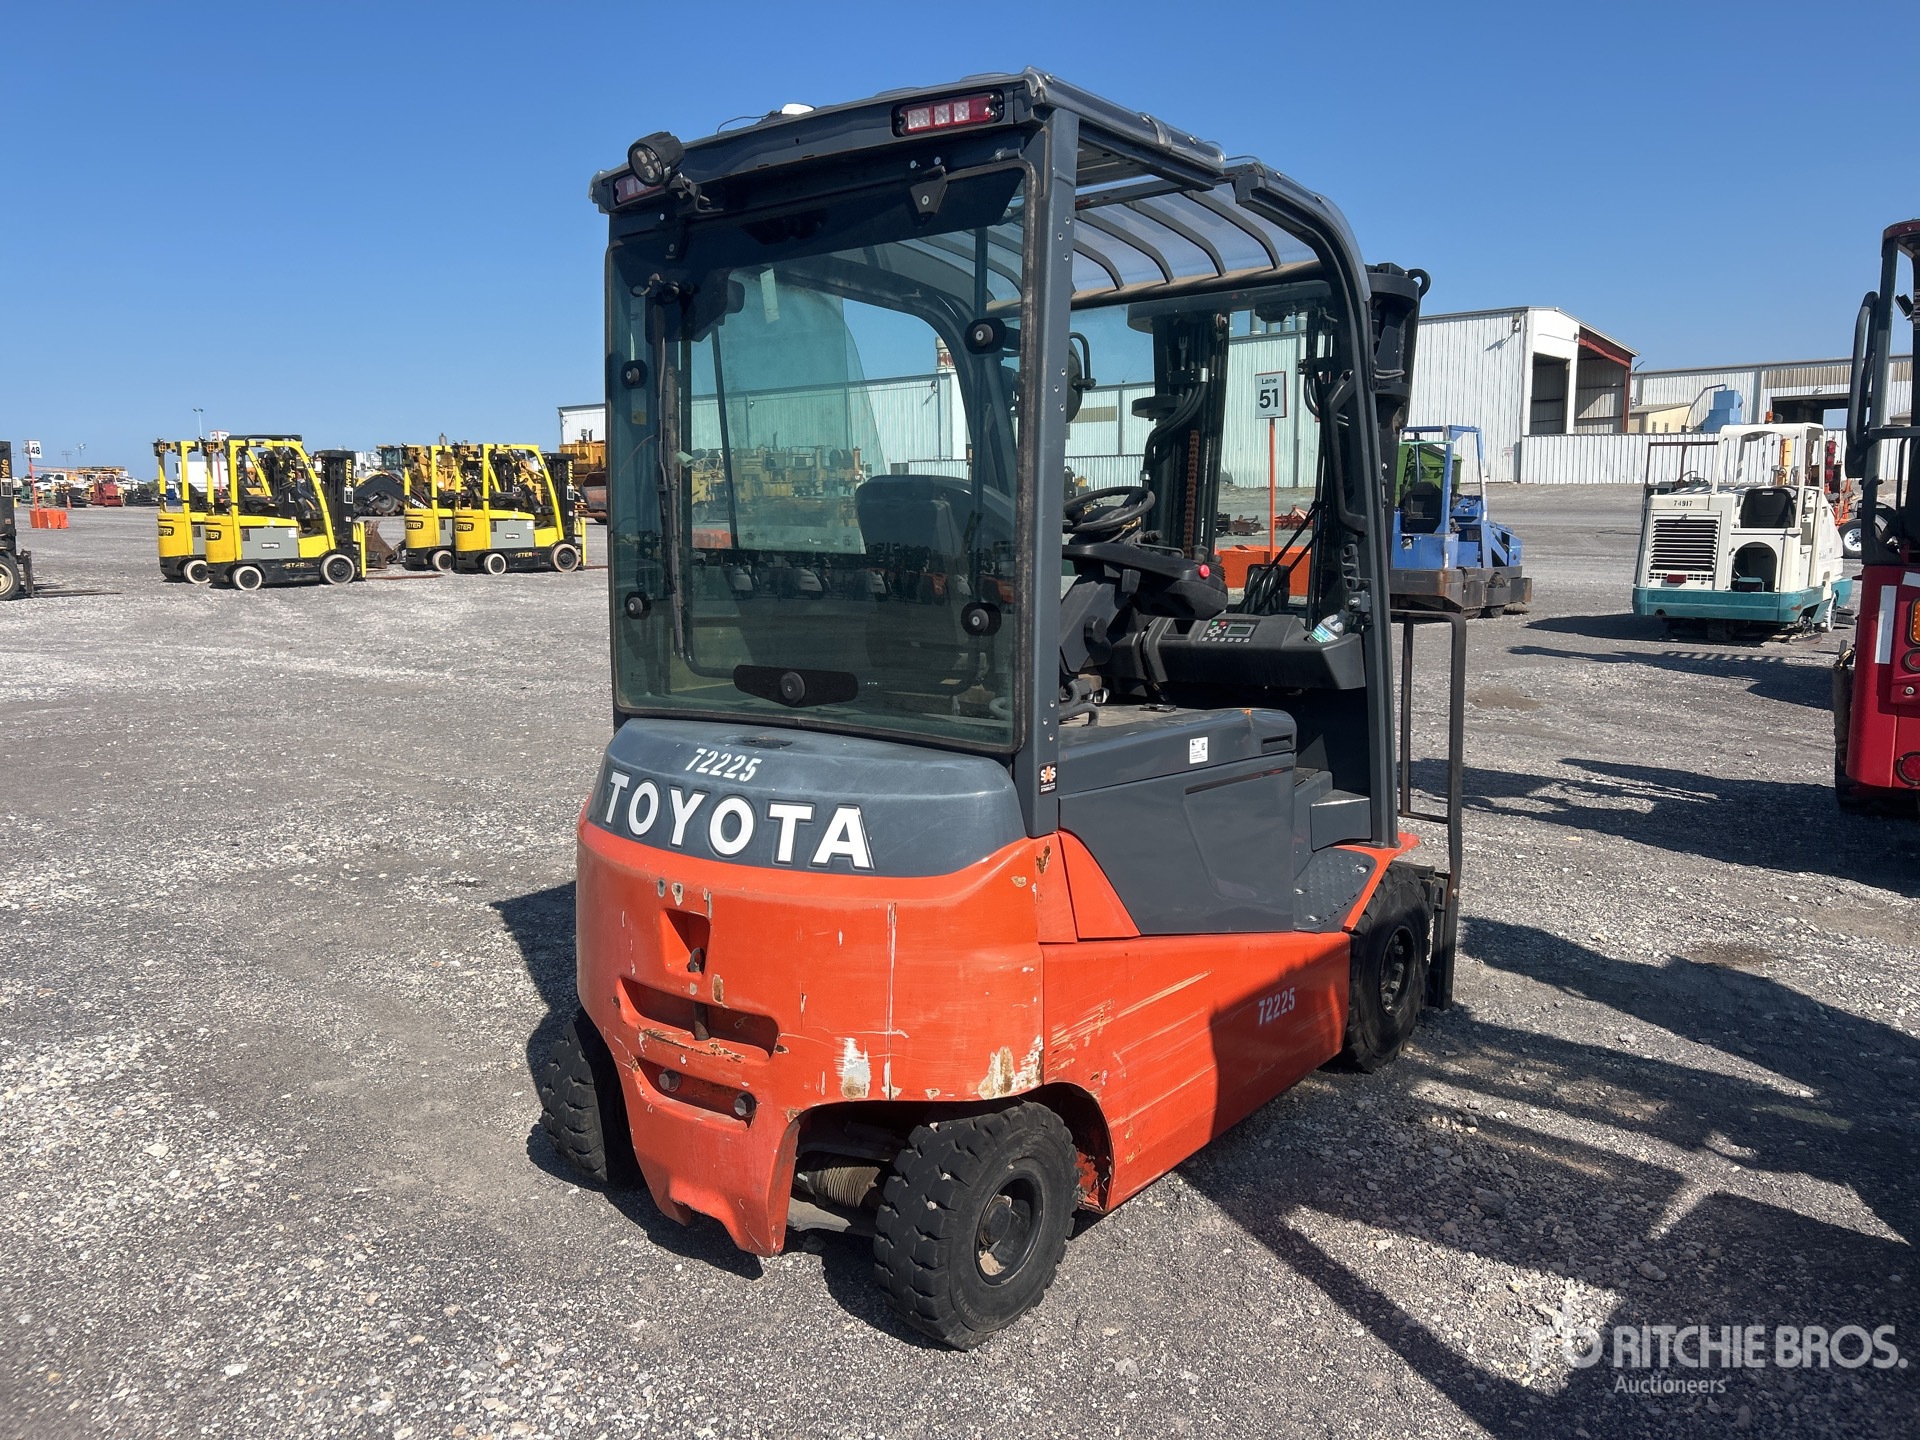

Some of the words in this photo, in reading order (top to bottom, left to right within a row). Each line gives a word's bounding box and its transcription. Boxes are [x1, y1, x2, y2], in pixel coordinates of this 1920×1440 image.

[1259, 388, 1278, 409] 51
[31, 446, 41, 455] 48
[1, 459, 9, 478] Yale
[685, 748, 763, 782] 72225
[1040, 765, 1056, 784] SAS
[604, 771, 875, 870] TOYOTA
[1259, 987, 1295, 1025] 72225
